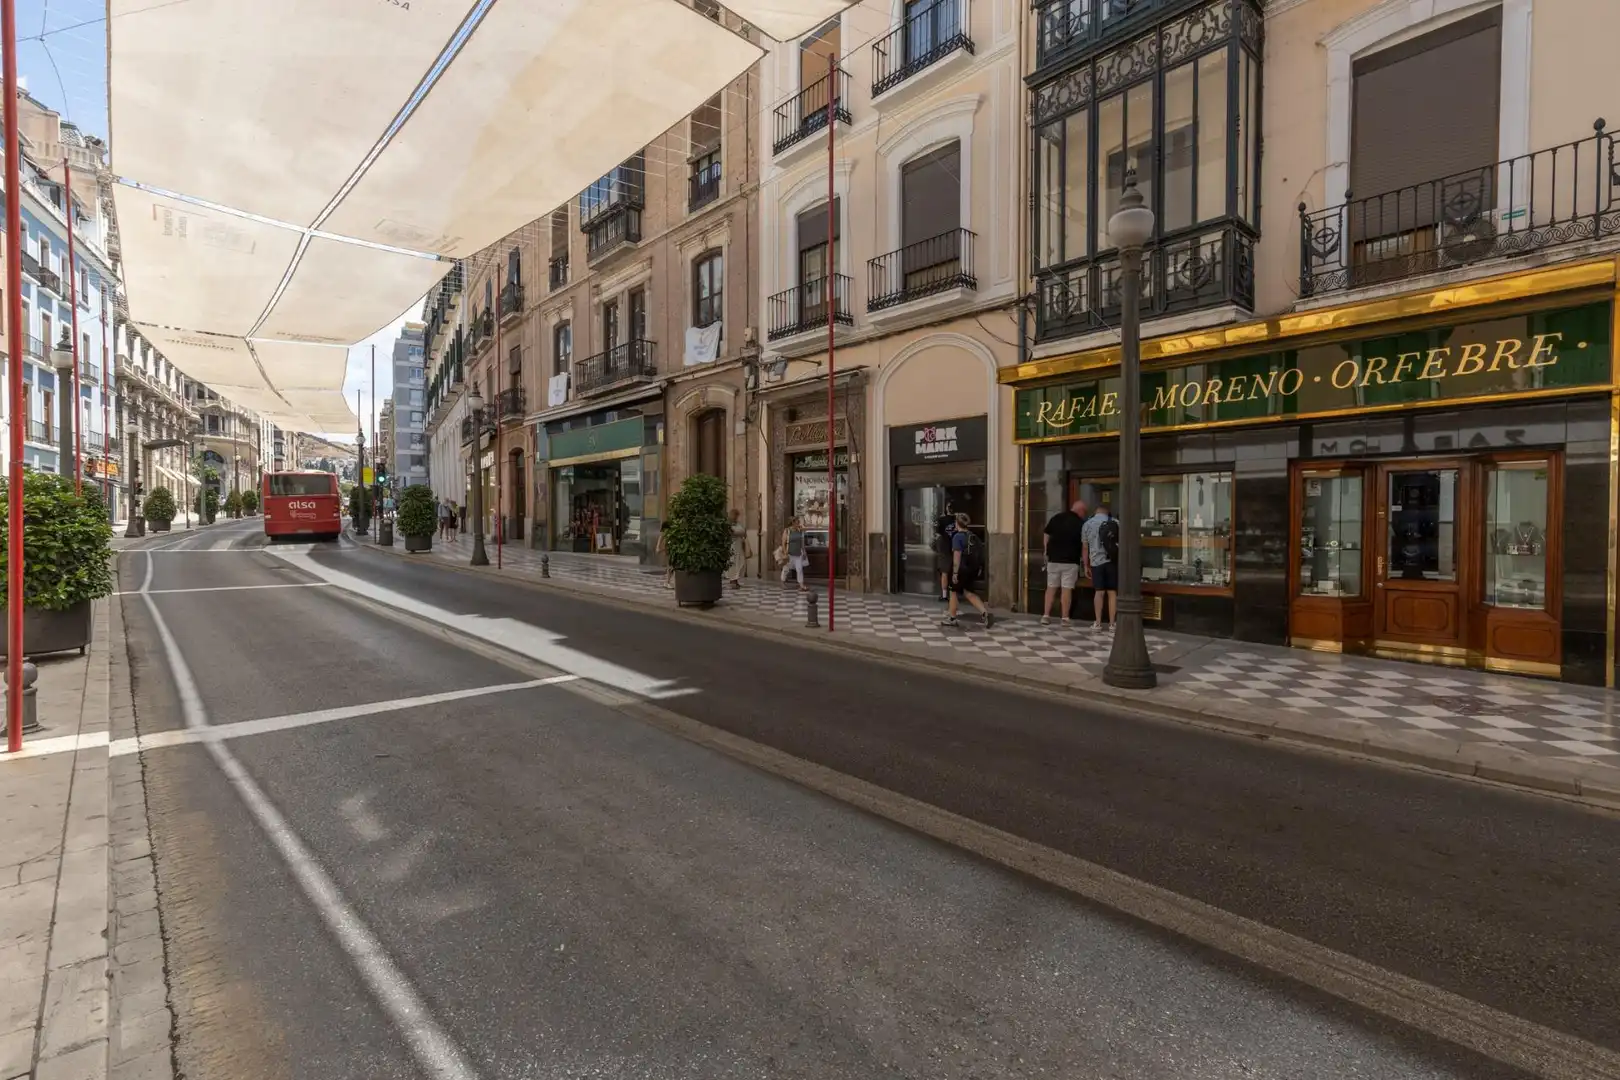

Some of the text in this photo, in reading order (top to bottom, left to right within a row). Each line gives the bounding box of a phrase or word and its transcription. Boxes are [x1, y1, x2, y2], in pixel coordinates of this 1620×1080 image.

[1036, 332, 1563, 428] RAFAE MORENO ORFEBRE
[288, 500, 316, 509] alsa
